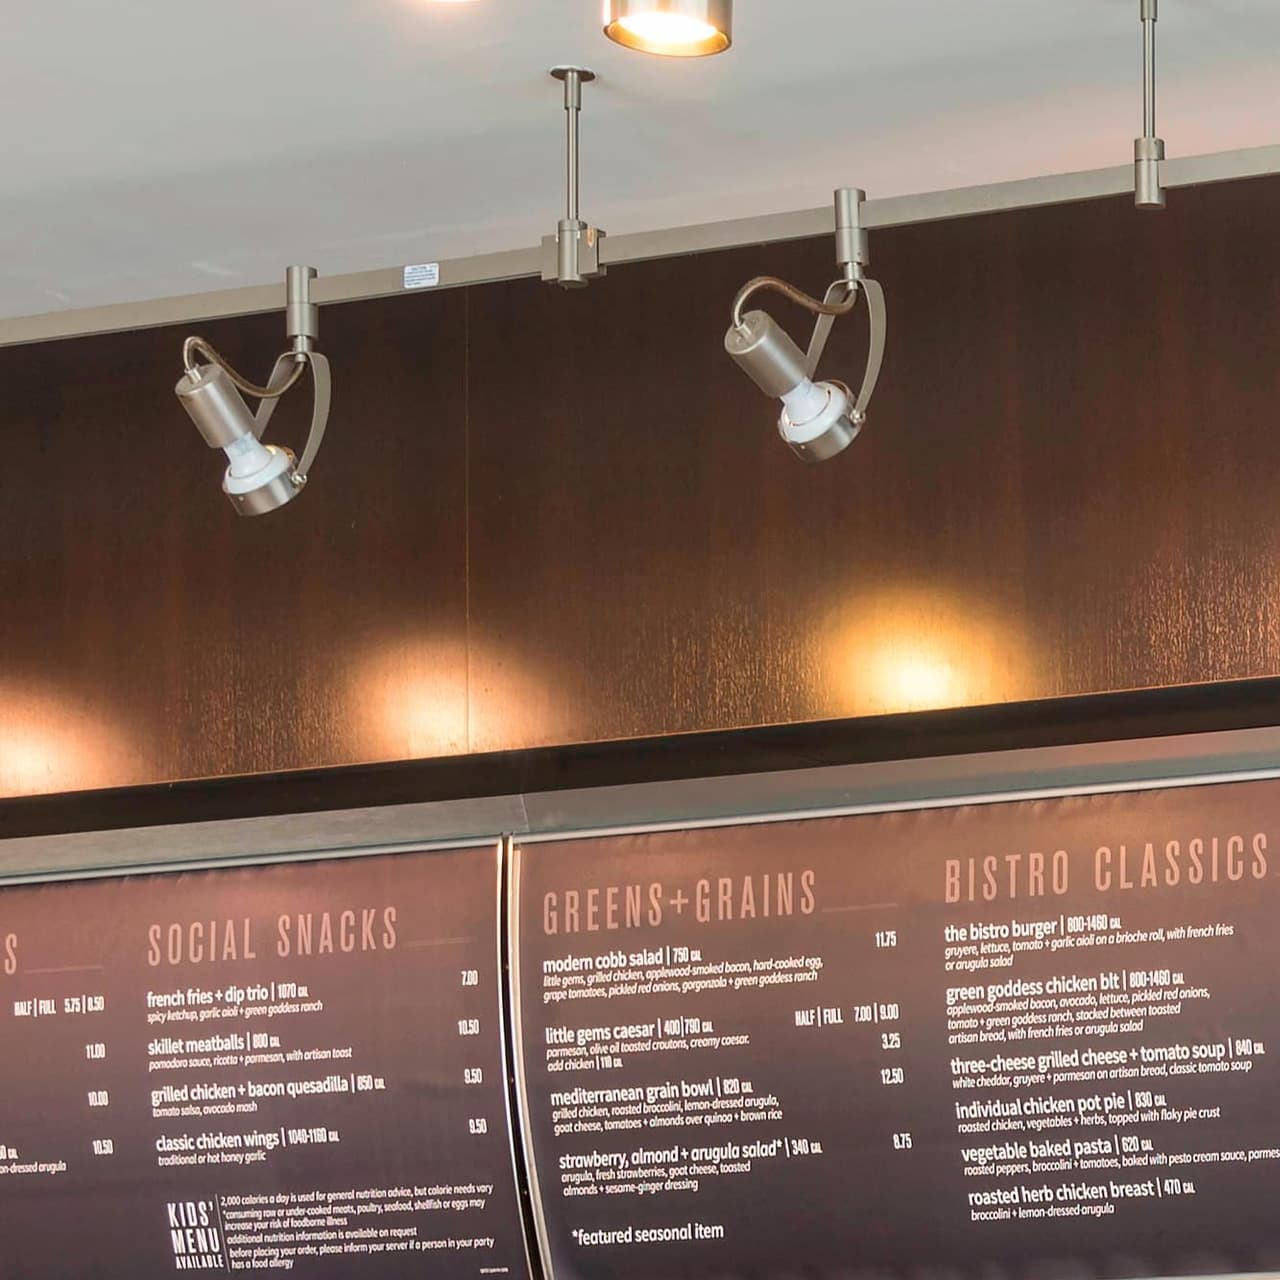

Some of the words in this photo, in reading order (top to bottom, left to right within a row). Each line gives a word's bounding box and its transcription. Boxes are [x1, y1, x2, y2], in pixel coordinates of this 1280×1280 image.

[946, 850, 1068, 902] BISTRO
[1096, 833, 1266, 890] CLASSICS
[148, 918, 256, 966] SOCIAL
[278, 907, 396, 956] SNACKS
[544, 955, 592, 973] modern
[596, 951, 626, 969] cobb
[629, 948, 663, 966] salad
[950, 1054, 1035, 1074] three-cheese
[1038, 1050, 1079, 1073] grilled
[1082, 1048, 1127, 1066] cheese
[1140, 1044, 1190, 1062] tomato
[1190, 1044, 1225, 1064] soup
[152, 1085, 188, 1106] grilled
[190, 1083, 236, 1100] chicken
[248, 1081, 284, 1096] bacon
[287, 1076, 348, 1098] quesadilla
[893, 1133, 912, 1149] 8.75
[961, 1142, 1027, 1163] vegetable
[1029, 1139, 1071, 1157] baked
[1074, 1138, 1112, 1158] pasta
[560, 1150, 628, 1169] strawberry,
[632, 1146, 678, 1164] almond
[691, 1142, 739, 1164] arugula
[968, 1186, 1019, 1205] roasted
[1021, 1185, 1053, 1202] herb
[1056, 1183, 1107, 1200] chicken
[1110, 1181, 1154, 1197] breast
[171, 1228, 219, 1254] MENU
[635, 1223, 692, 1242] seasonal
[695, 1223, 723, 1238] item
[176, 1254, 224, 1269] AVAILABLE
